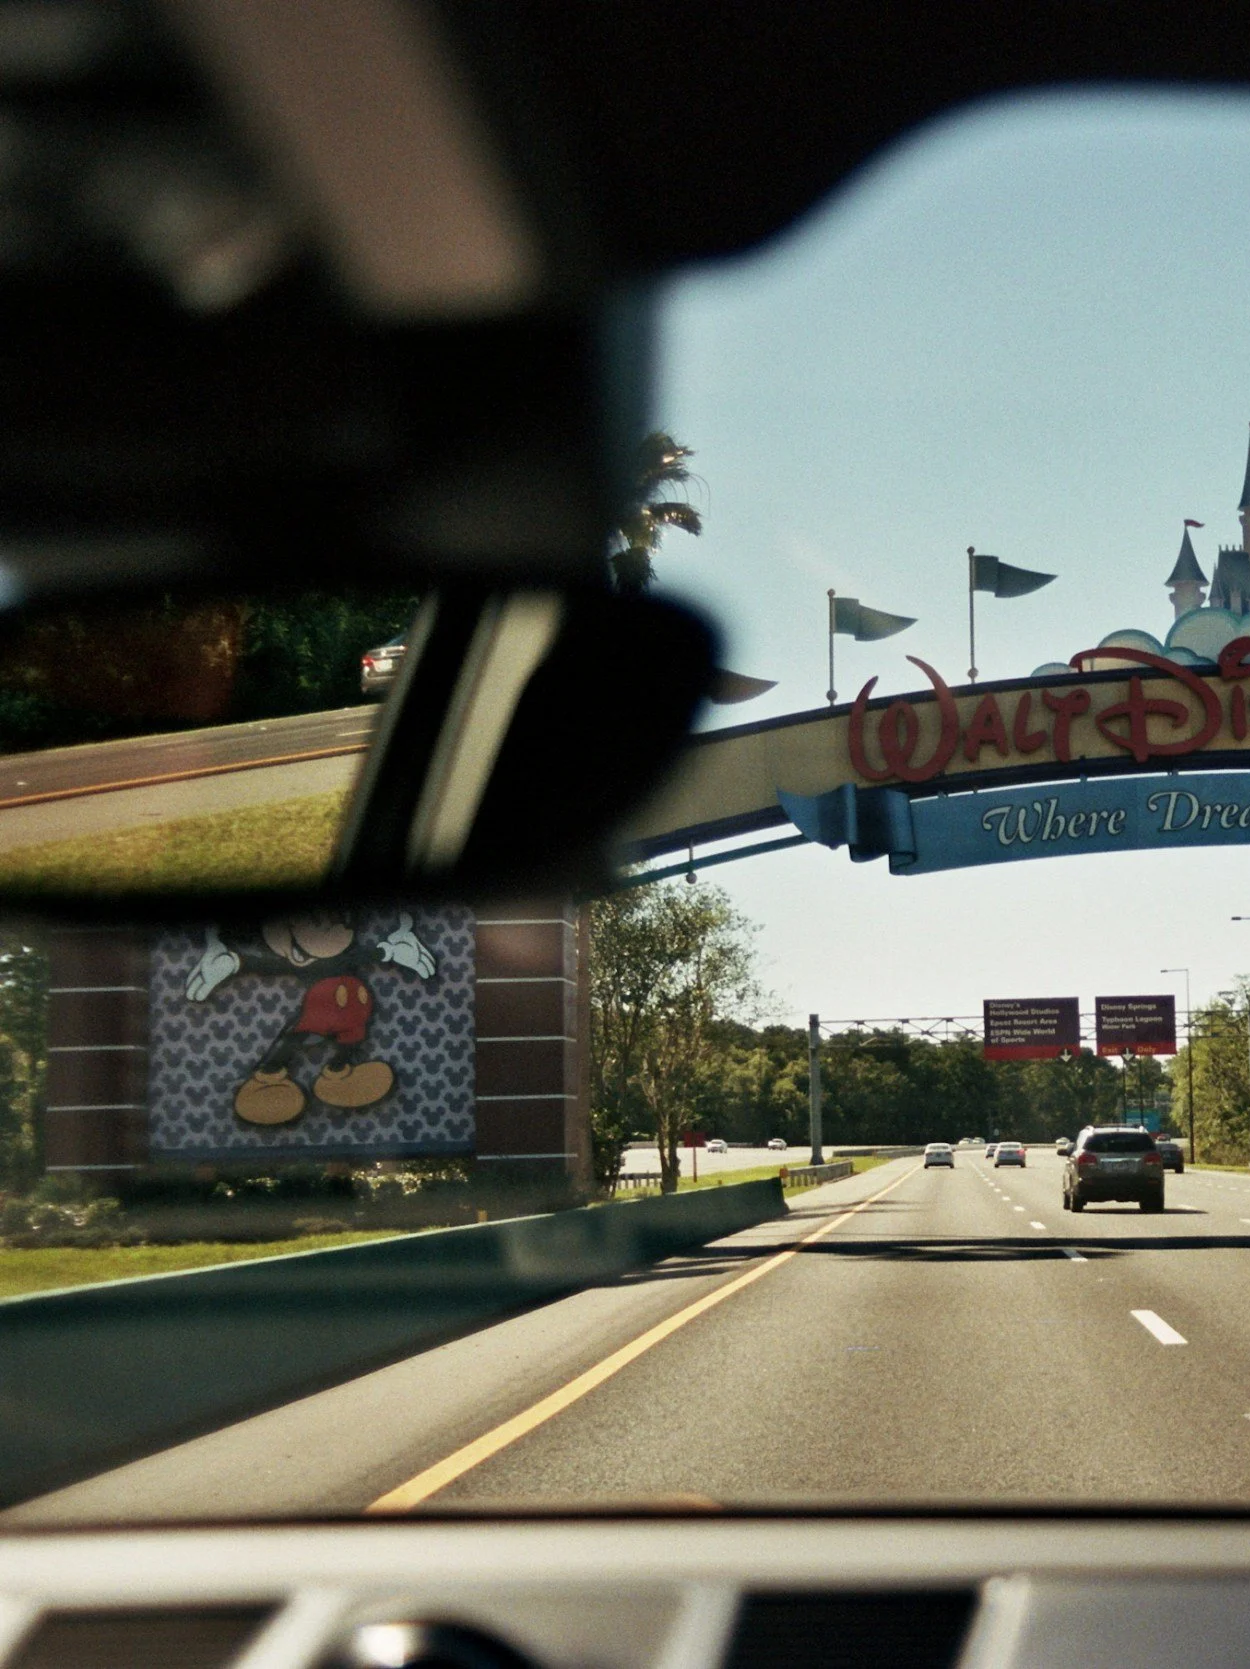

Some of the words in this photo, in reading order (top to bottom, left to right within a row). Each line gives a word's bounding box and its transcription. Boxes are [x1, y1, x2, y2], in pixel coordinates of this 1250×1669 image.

[982, 800, 1126, 847] Where
[1101, 1003, 1126, 1011] Disney
[1128, 1002, 1158, 1012] Springs
[989, 1009, 1029, 1017] Hollywood
[1101, 1016, 1134, 1024] Typhoon
[1135, 1016, 1163, 1024] Lagoon
[1013, 1028, 1032, 1036] Wide
[1033, 1027, 1056, 1035] World
[1000, 1036, 1026, 1044] Sports
[1101, 1046, 1119, 1054] Exit
[1137, 1046, 1157, 1054] Only
